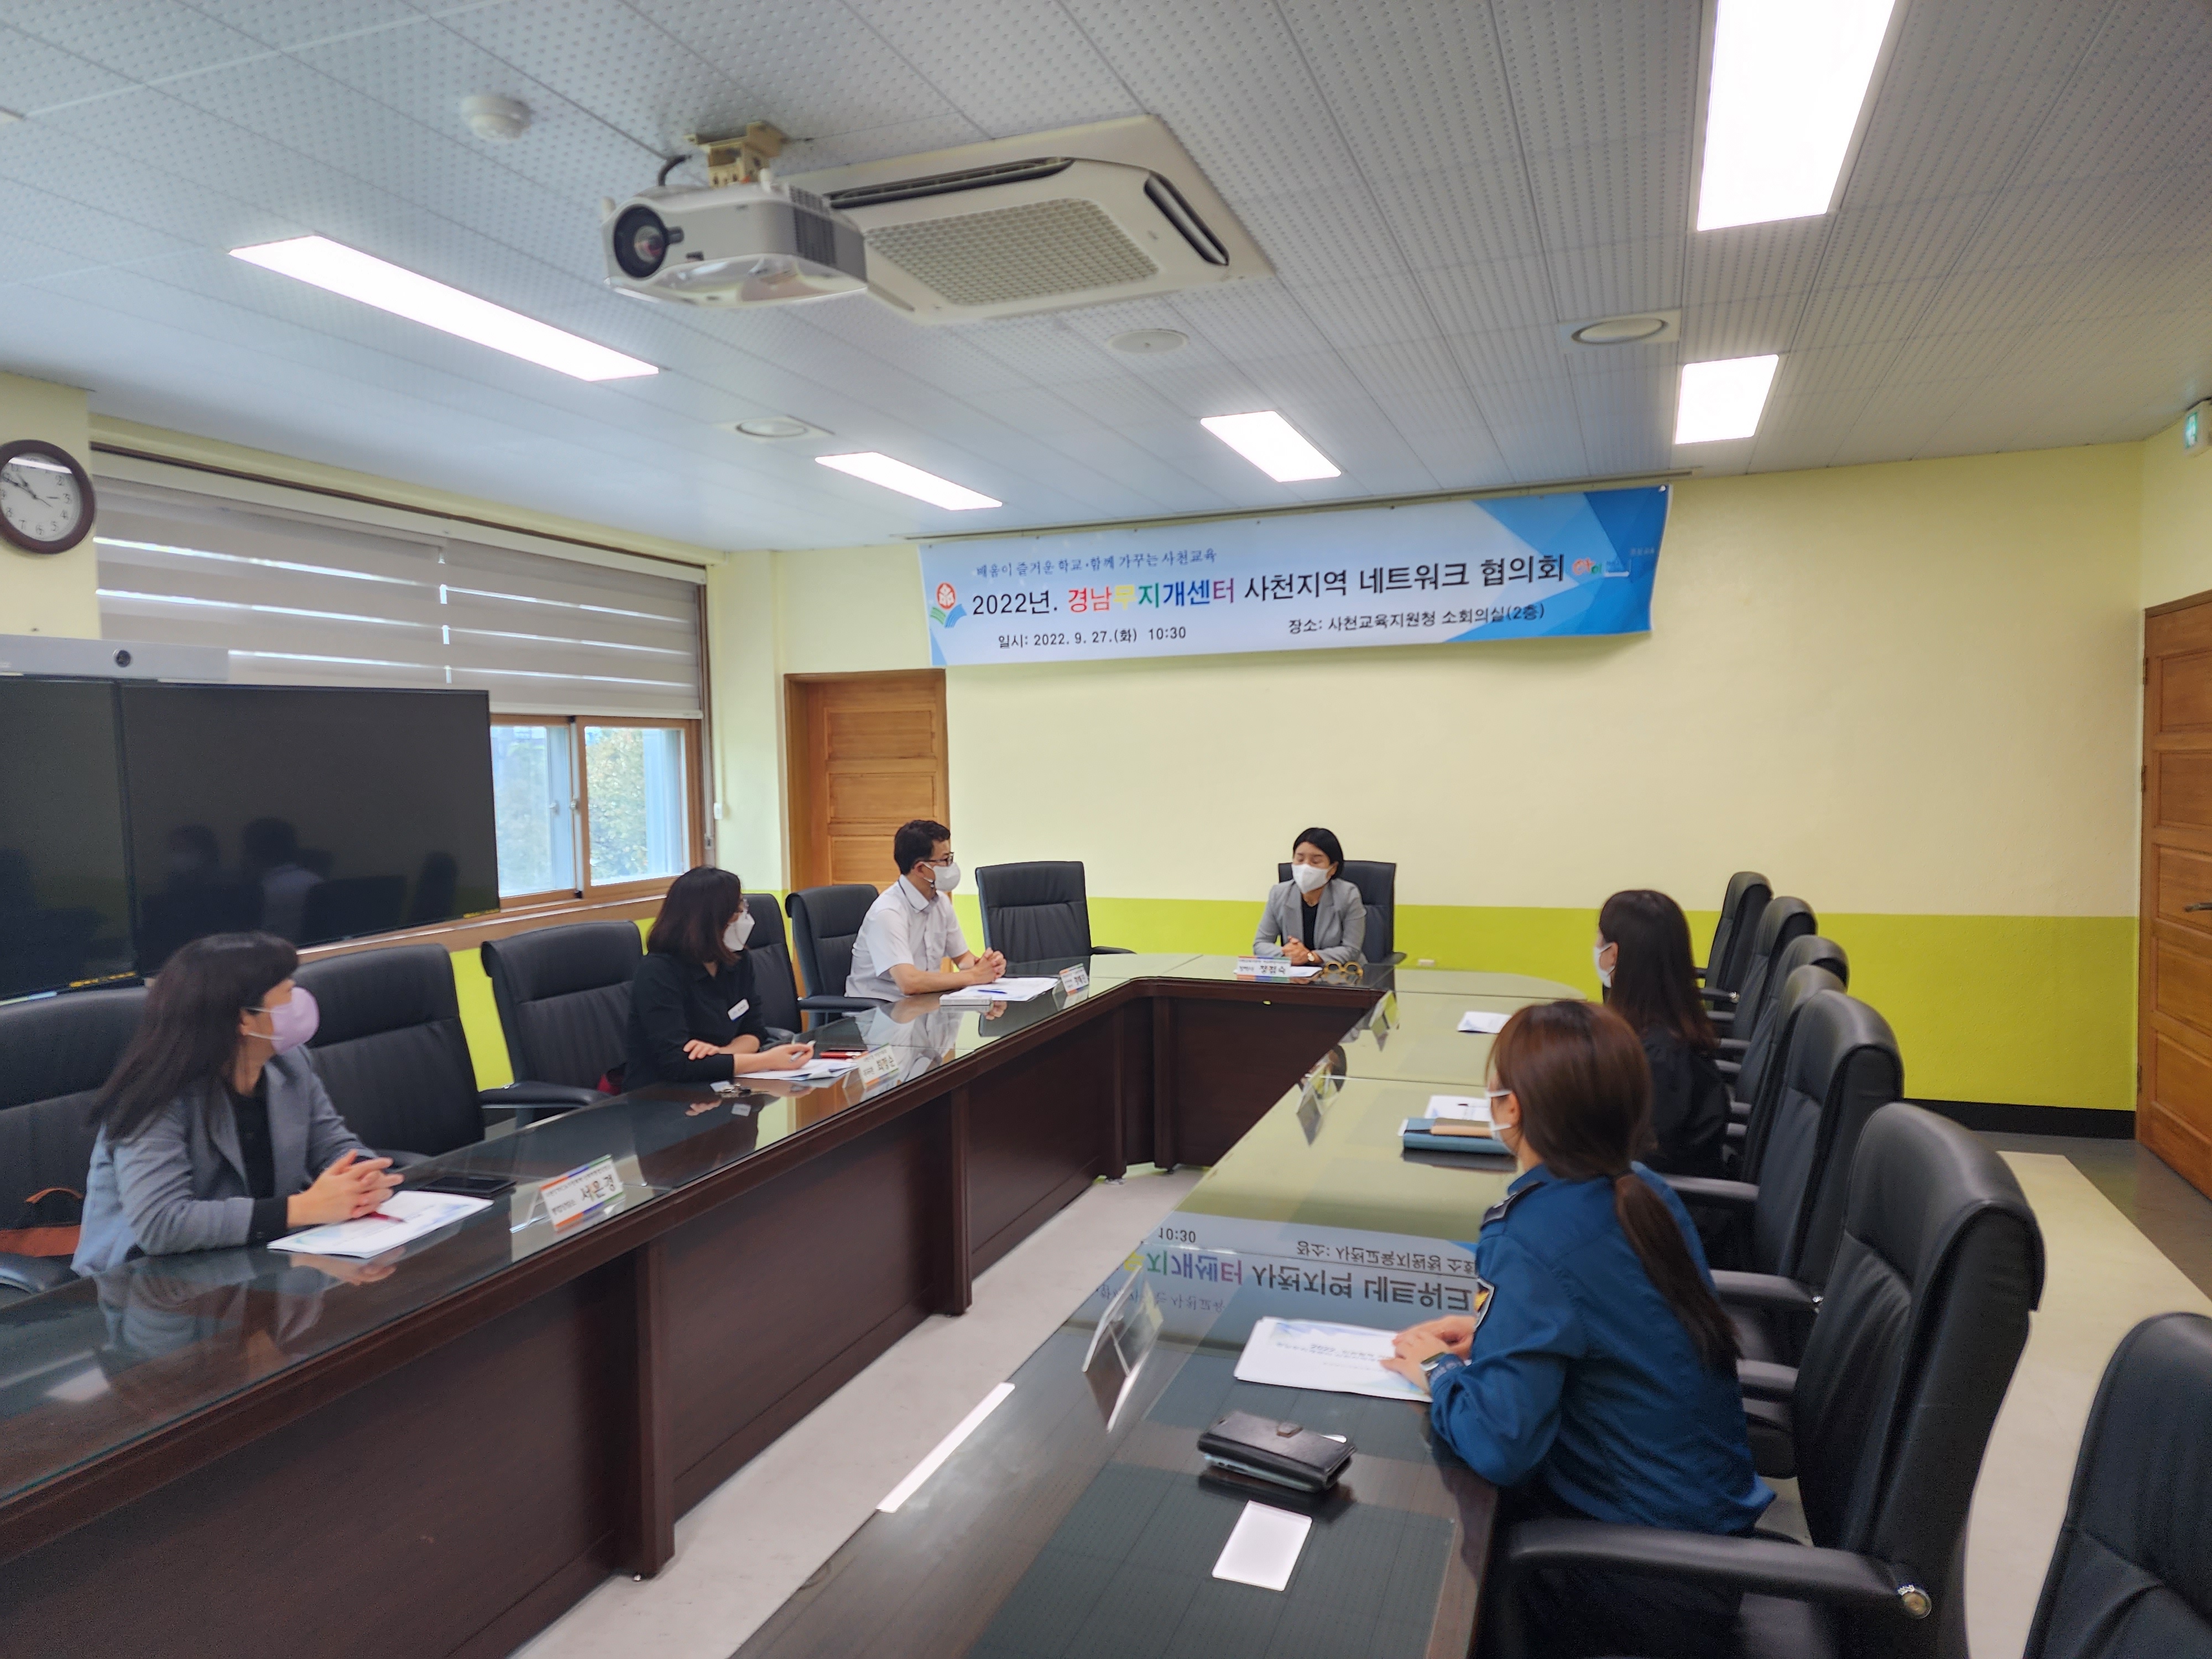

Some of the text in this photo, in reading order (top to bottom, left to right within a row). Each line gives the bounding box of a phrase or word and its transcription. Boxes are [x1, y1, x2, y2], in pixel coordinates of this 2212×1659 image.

[56, 475, 65, 486] 2
[63, 493, 71, 503] 3
[60, 510, 69, 520] 4
[19, 519, 27, 529] 7
[50, 521, 59, 531] 5
[976, 562, 1013, 578] 배움이
[1016, 559, 1055, 576] 즐거운
[1119, 551, 1159, 570] 가꾸는
[1162, 548, 1217, 566] 사천교육
[973, 554, 1565, 615] 2022년. 경남무지개센터 사천지역 네트워크 협의회
[1288, 602, 1545, 635] 장소: 사천교육지원청 소회의실(2층)
[999, 633, 1029, 649] 일시:
[1034, 632, 1070, 647] 2022.
[1074, 632, 1087, 645] 9.
[1148, 626, 1187, 641] 10:30
